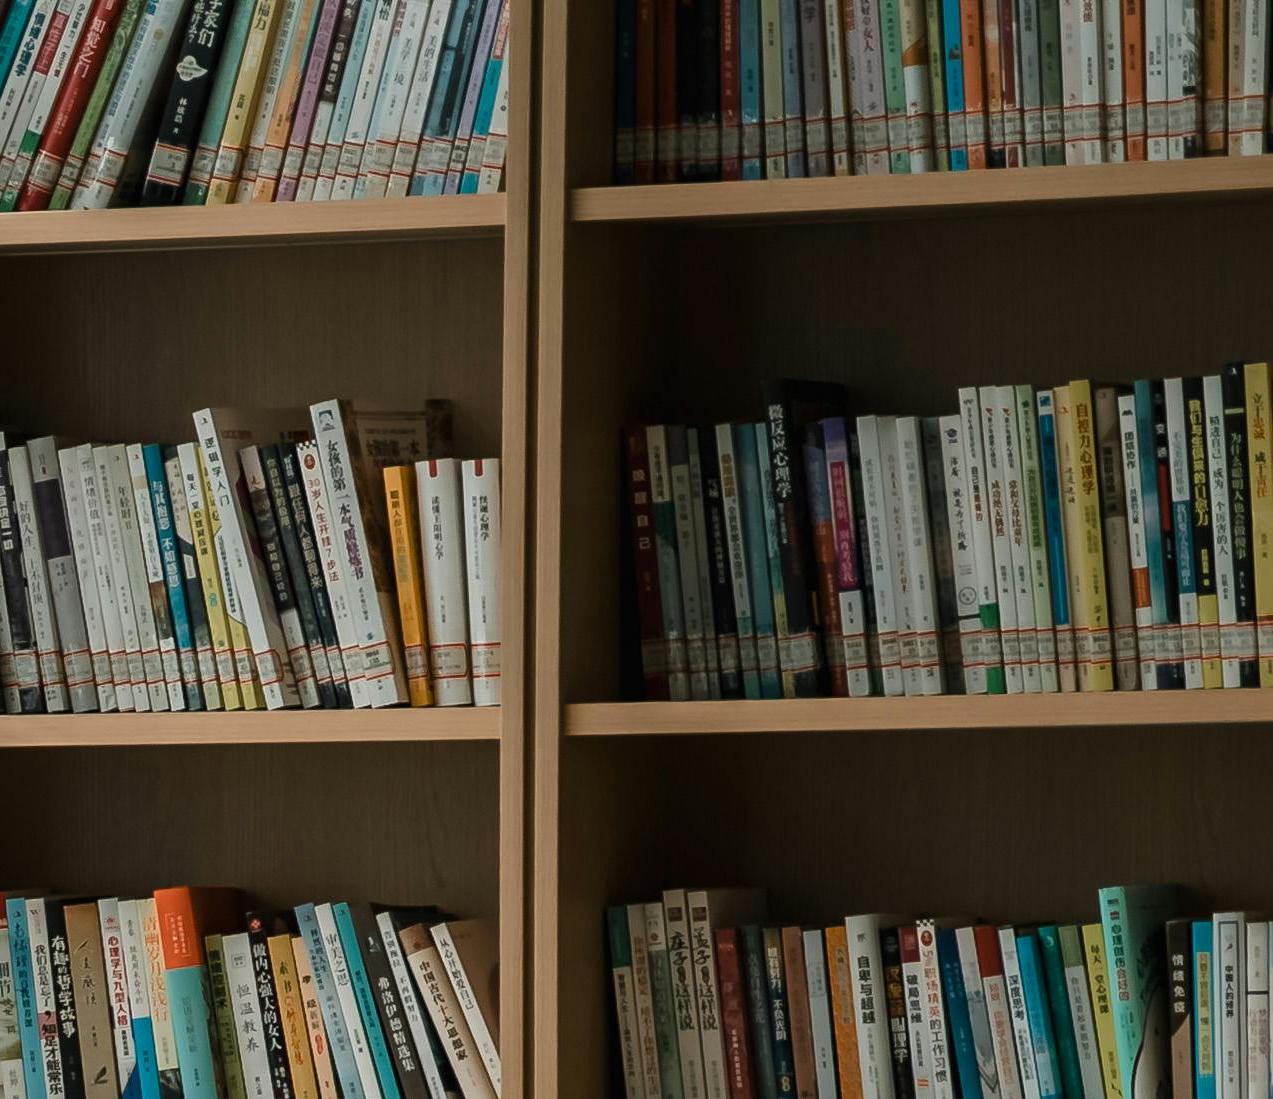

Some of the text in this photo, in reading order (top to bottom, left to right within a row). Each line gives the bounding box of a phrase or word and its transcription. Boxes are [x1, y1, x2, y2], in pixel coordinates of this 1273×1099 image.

[204, 437, 231, 507] 逻辑学入门
[1075, 403, 1095, 496] 自控力心理学
[84, 476, 100, 521] 情绪价值
[308, 478, 340, 582] 30岁人生开挂7步法
[326, 440, 364, 580] 女孩的第一本气质修炼书
[51, 935, 78, 1039] 有趣的哲学故事
[107, 935, 129, 1026] 心理学与九型人格
[236, 983, 260, 1053] 恒温教养
[252, 942, 283, 1052] 做内心强大的女人
[418, 961, 469, 1061] 中国古代十大思想家
[856, 956, 876, 1024] 自卑与超越
